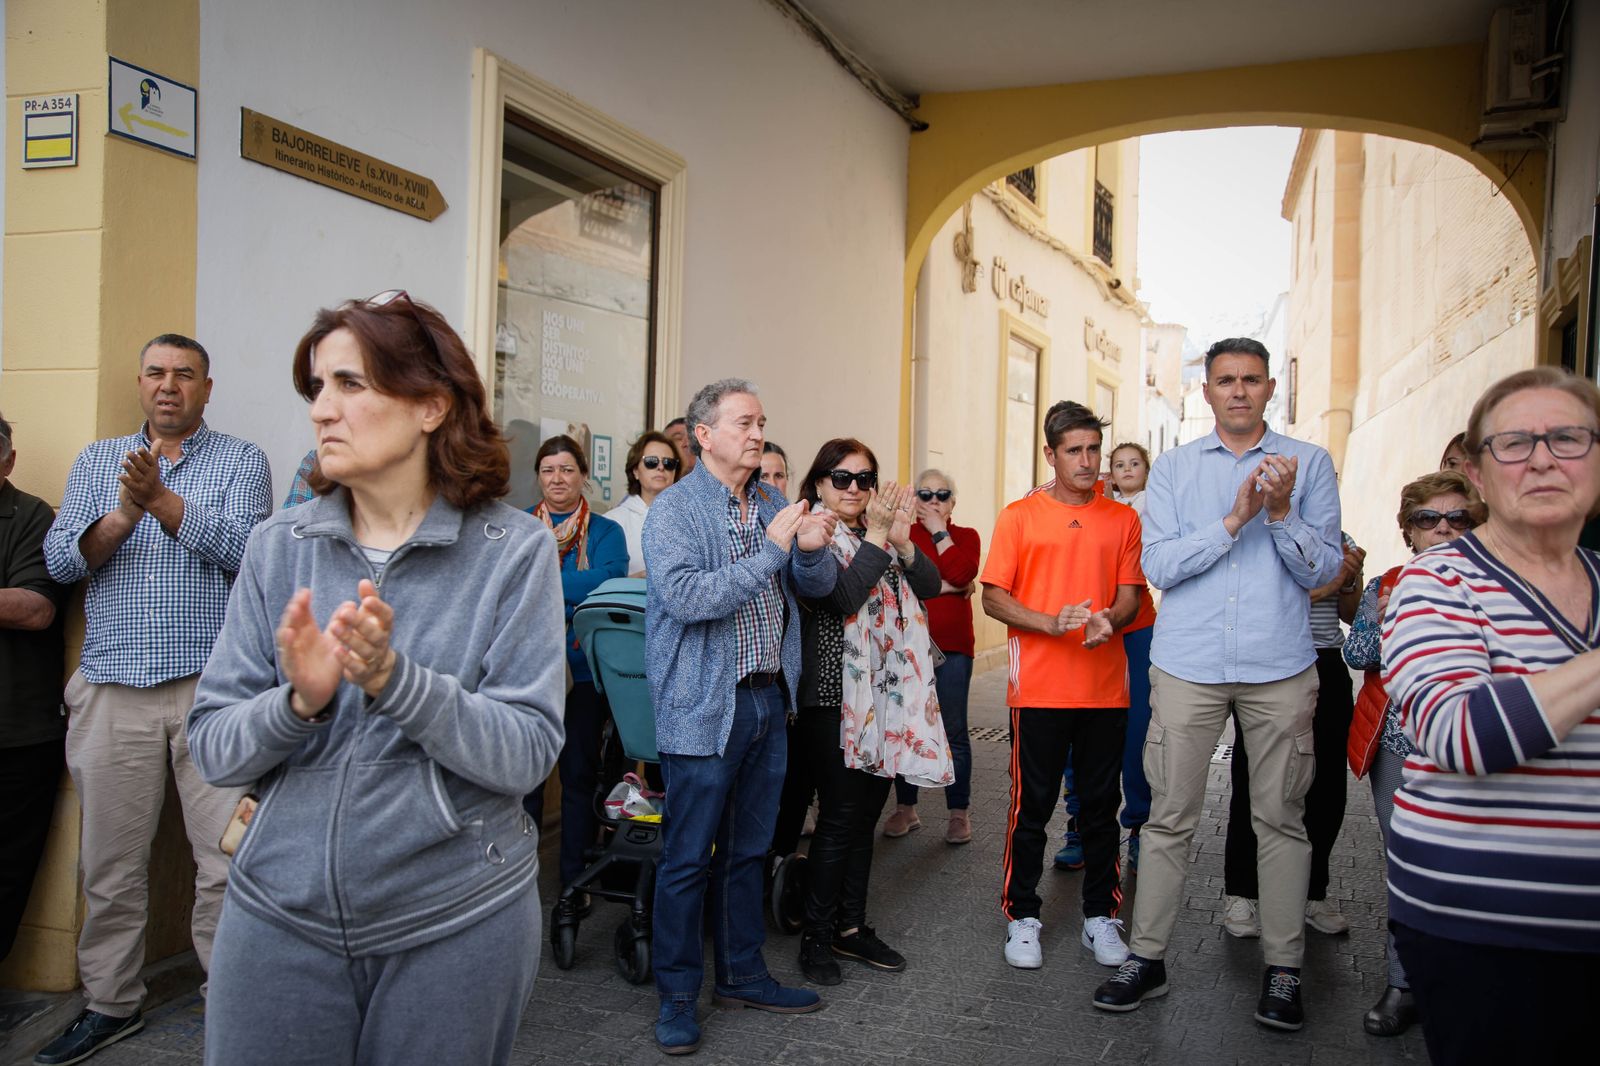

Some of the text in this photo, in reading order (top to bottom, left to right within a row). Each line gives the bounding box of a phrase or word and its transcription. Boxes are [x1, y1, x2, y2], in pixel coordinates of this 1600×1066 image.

[25, 98, 72, 111] PR-A 354
[272, 127, 361, 173] BAJORRELIEVE
[275, 148, 315, 173] Itinerario
[394, 190, 403, 204] de
[543, 311, 565, 328] NOS
[543, 325, 560, 341] SER
[541, 368, 559, 383] SER
